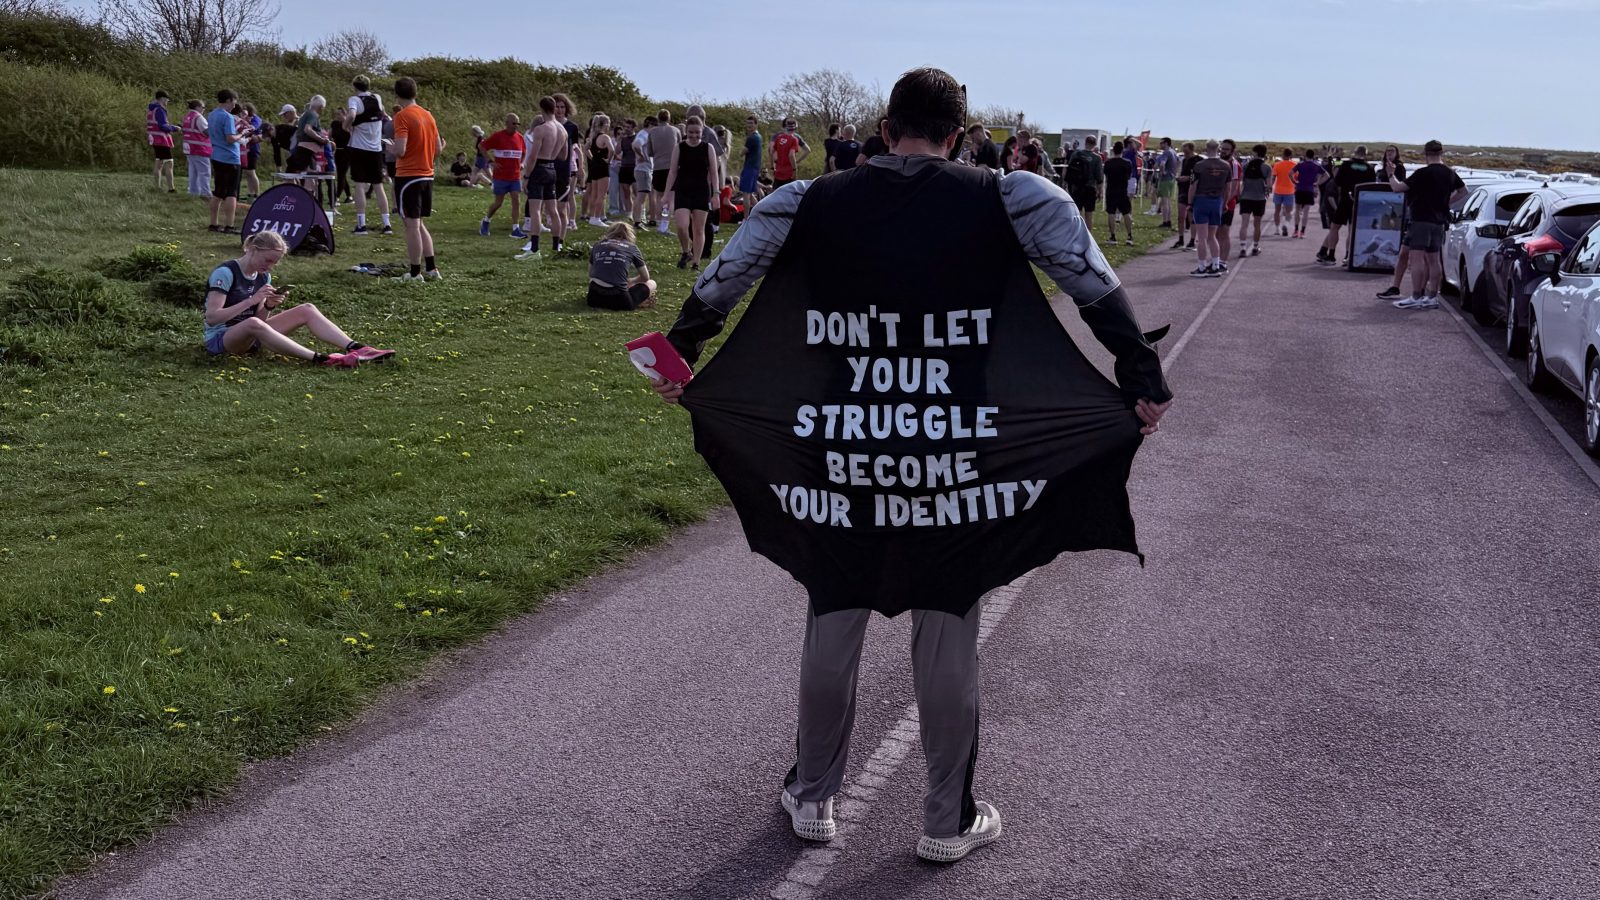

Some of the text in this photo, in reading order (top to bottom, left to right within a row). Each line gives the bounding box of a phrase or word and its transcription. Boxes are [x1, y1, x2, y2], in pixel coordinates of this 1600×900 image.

[251, 219, 302, 237] START
[806, 305, 992, 348] DON'T LET
[847, 356, 952, 394] YOUR
[793, 403, 999, 440] STRUGGLE
[826, 451, 979, 488] BECOME
[769, 479, 1048, 528] YOUR IDENTITY
